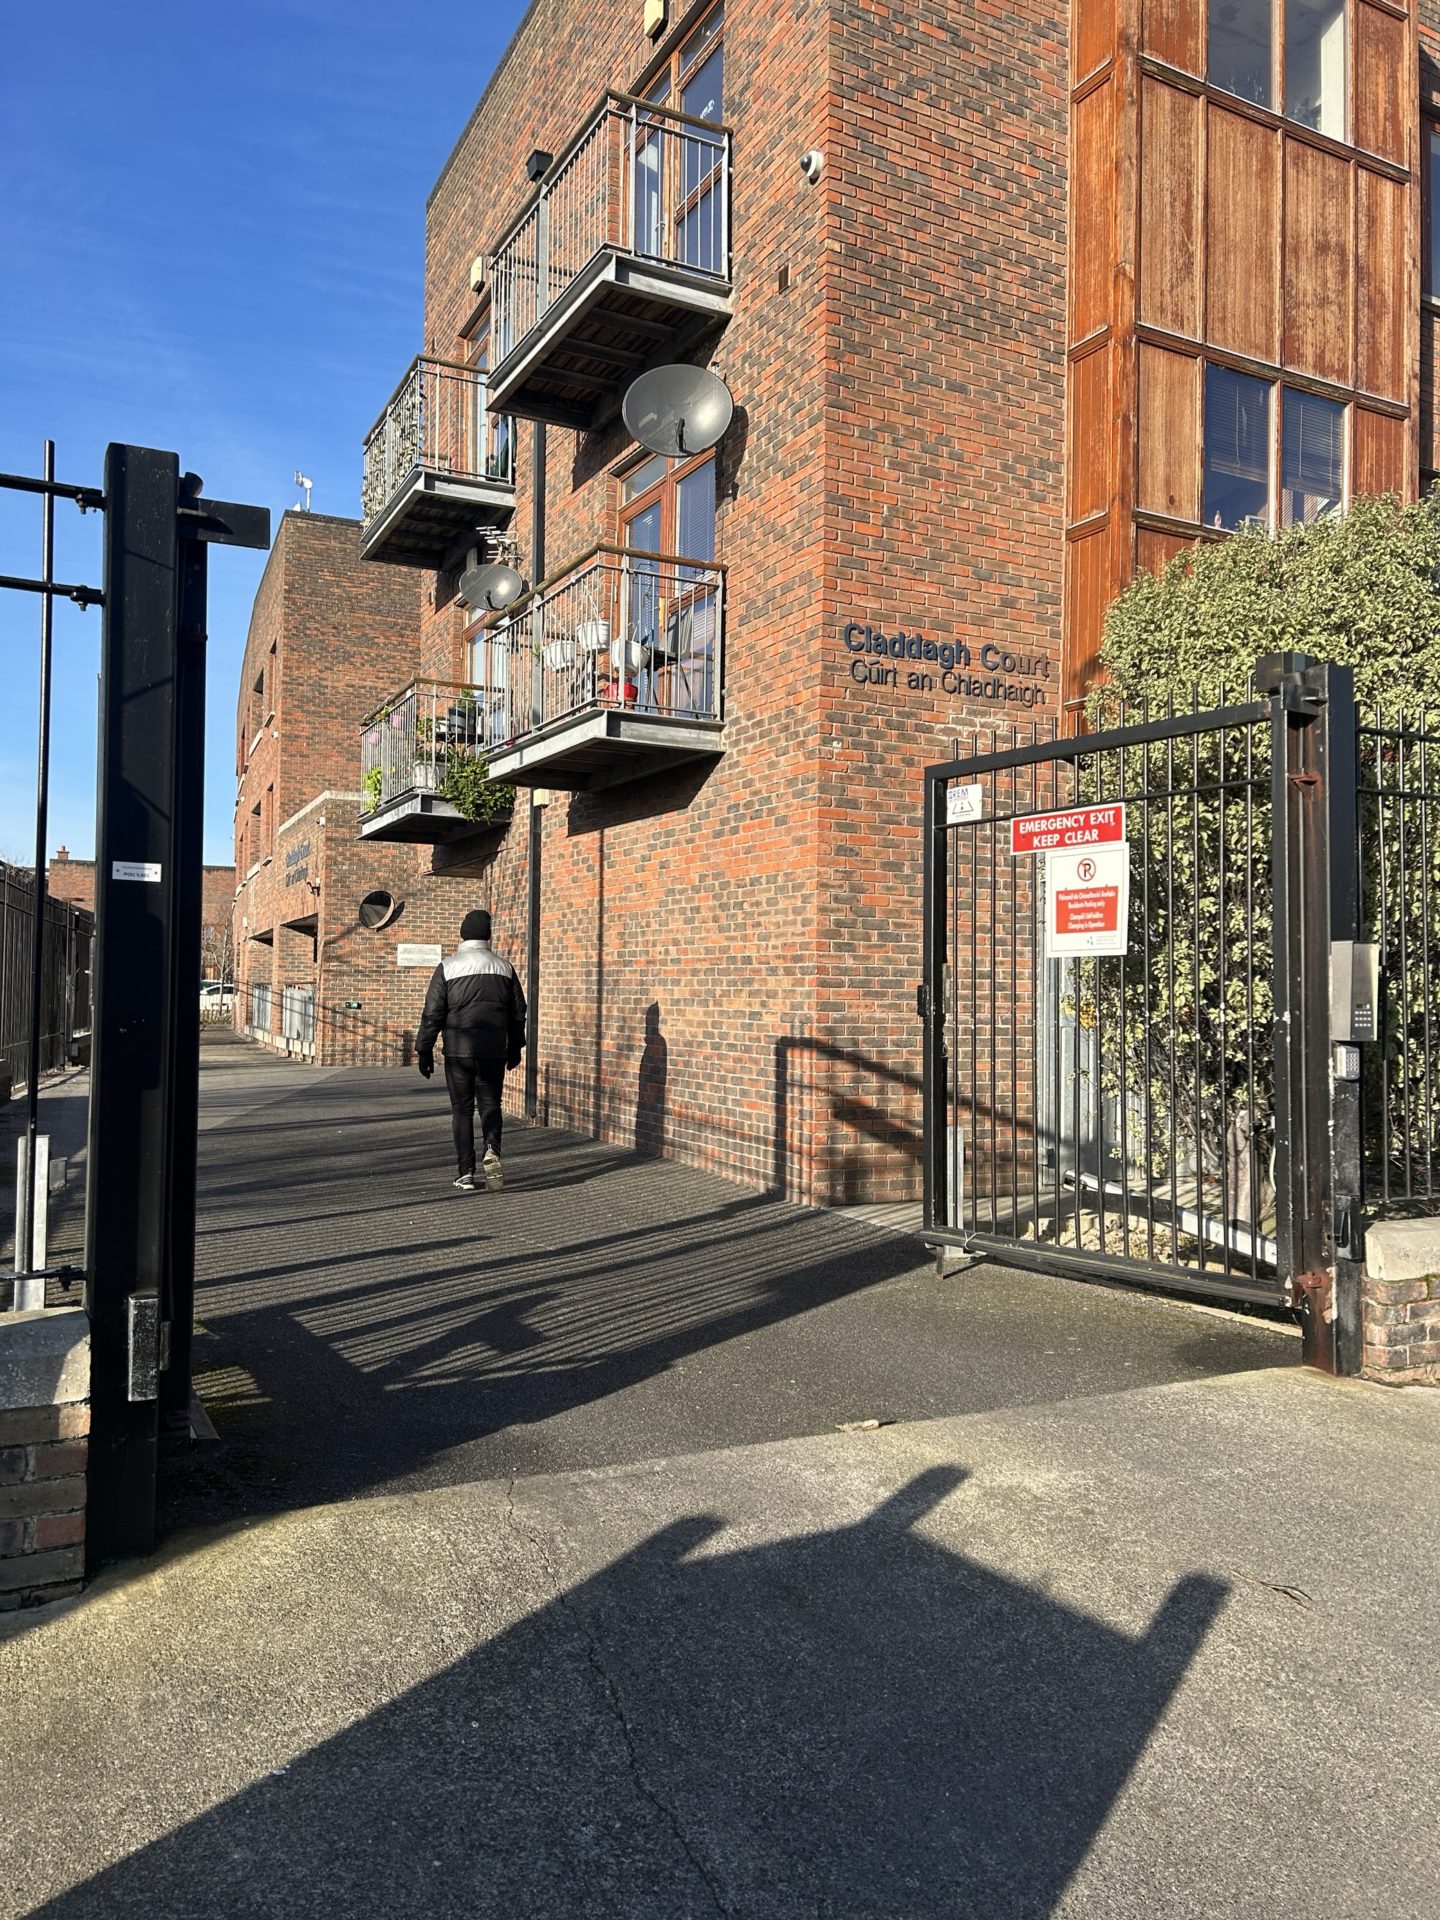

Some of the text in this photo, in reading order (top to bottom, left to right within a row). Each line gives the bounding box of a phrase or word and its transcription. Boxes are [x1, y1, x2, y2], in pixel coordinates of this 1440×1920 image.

[844, 623, 1050, 677] Claddagh Court
[850, 658, 1046, 707] Cúirt an Chladhaigh
[1019, 810, 1115, 834] EMERGENCY EXIT
[1033, 829, 1099, 848] KEEP CLEAR
